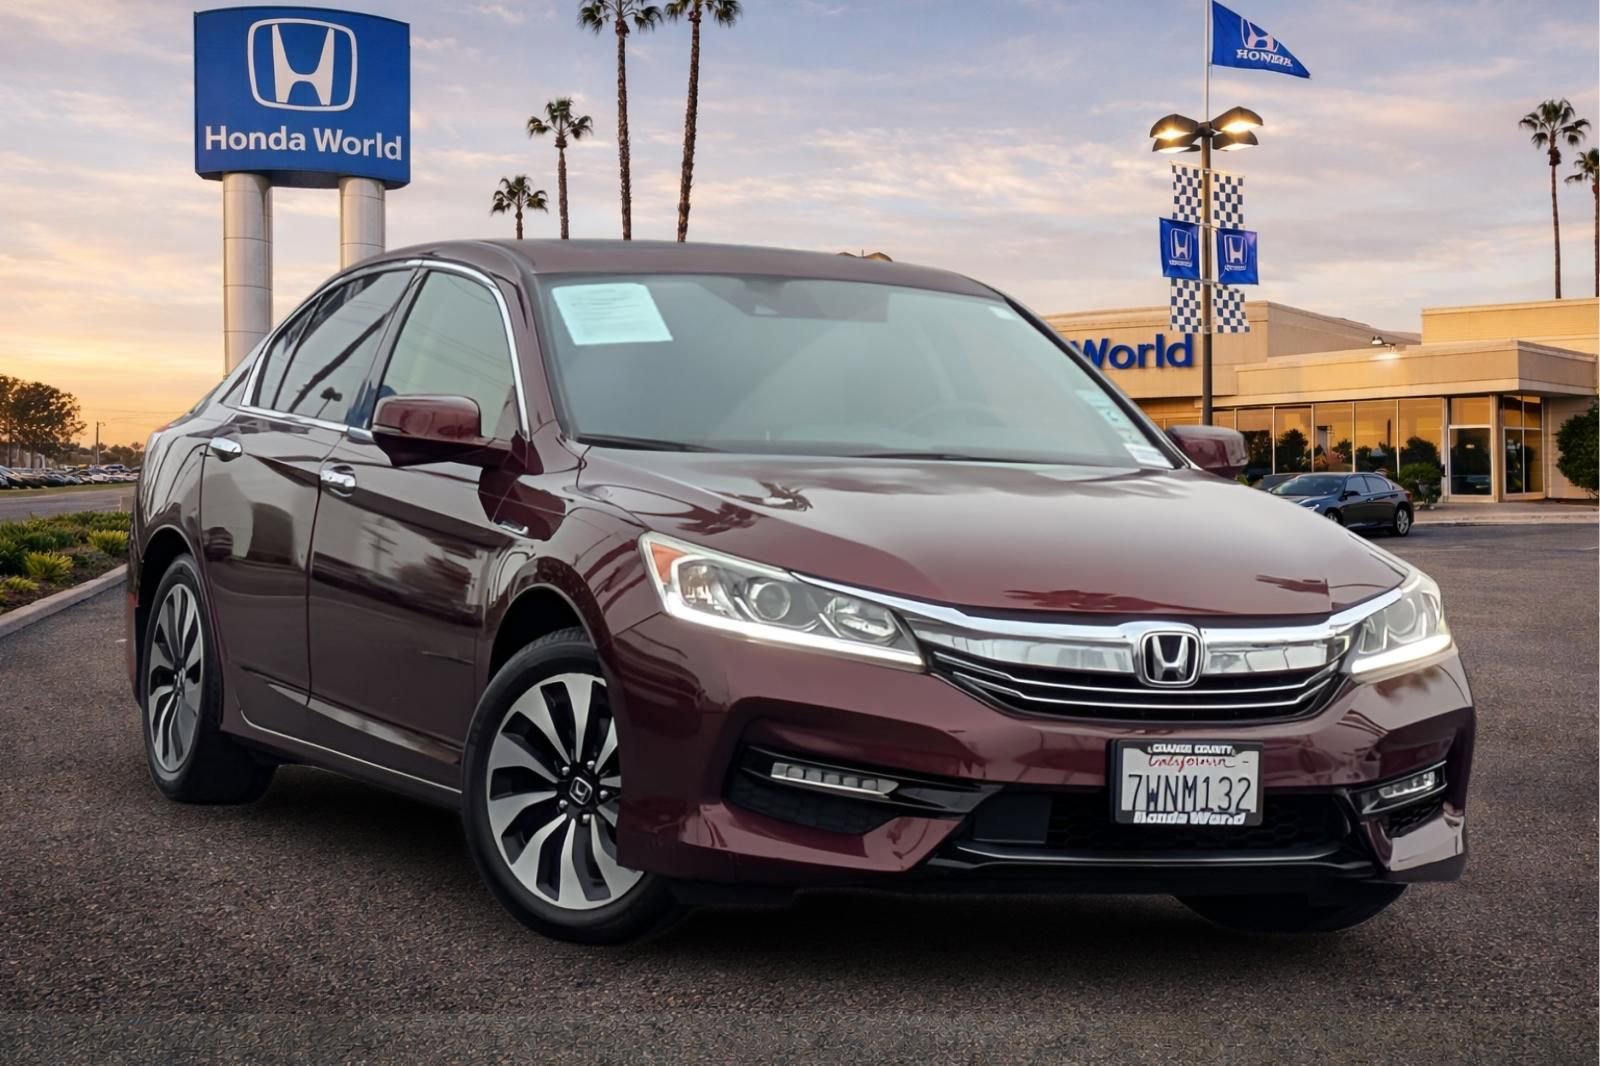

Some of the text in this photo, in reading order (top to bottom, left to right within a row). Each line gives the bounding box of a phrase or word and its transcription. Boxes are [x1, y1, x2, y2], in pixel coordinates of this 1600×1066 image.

[1236, 48, 1293, 67] HONDA
[205, 125, 402, 161] Honda World
[1128, 774, 1251, 812] 7WNM132
[1133, 811, 1188, 824] Honda
